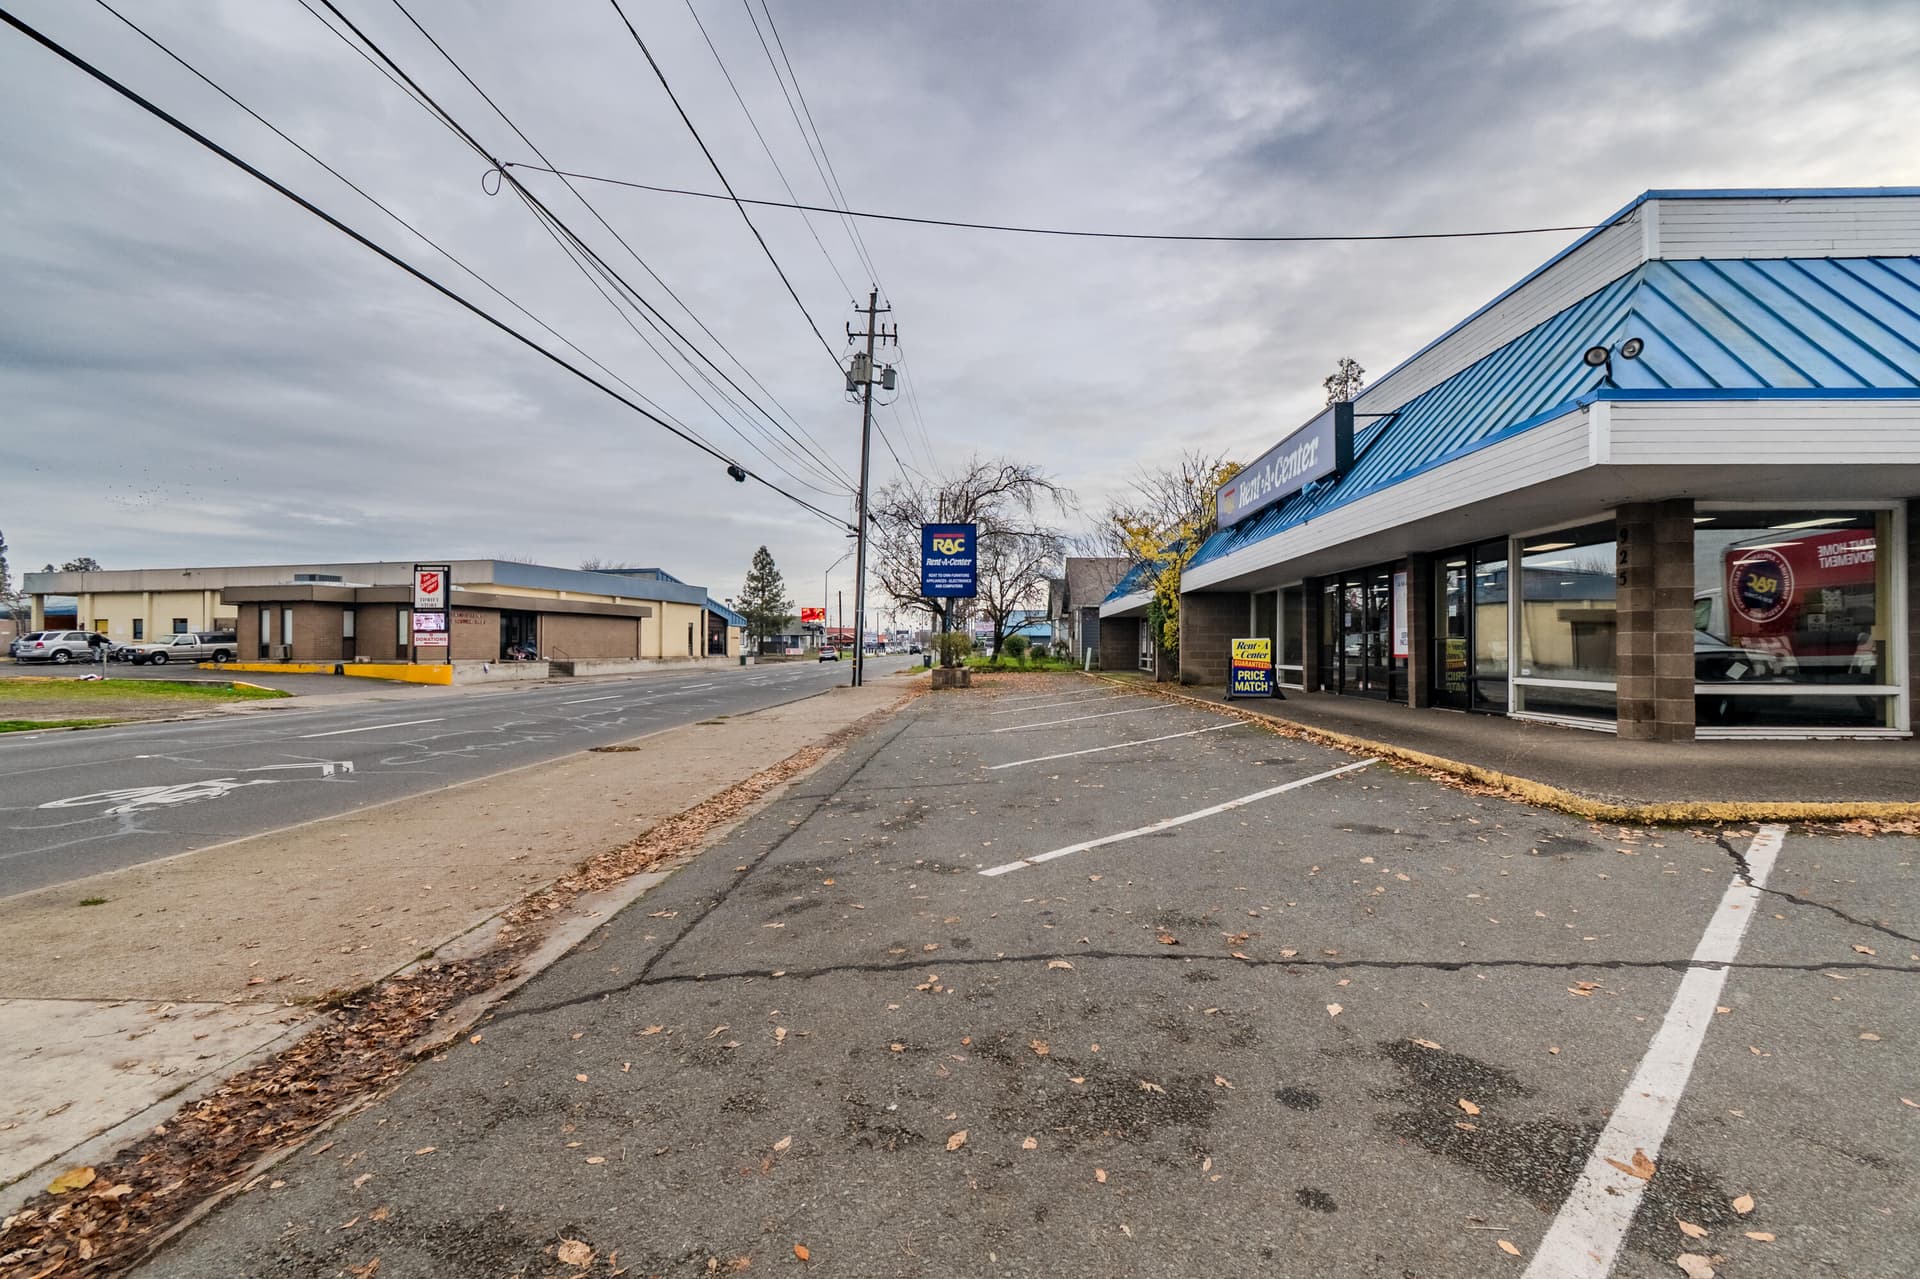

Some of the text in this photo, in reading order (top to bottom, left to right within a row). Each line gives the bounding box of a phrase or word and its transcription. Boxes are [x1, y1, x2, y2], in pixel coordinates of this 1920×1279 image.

[933, 538, 966, 555] RAC
[1237, 670, 1266, 681] PRICE
[1235, 681, 1268, 691] MATCH
